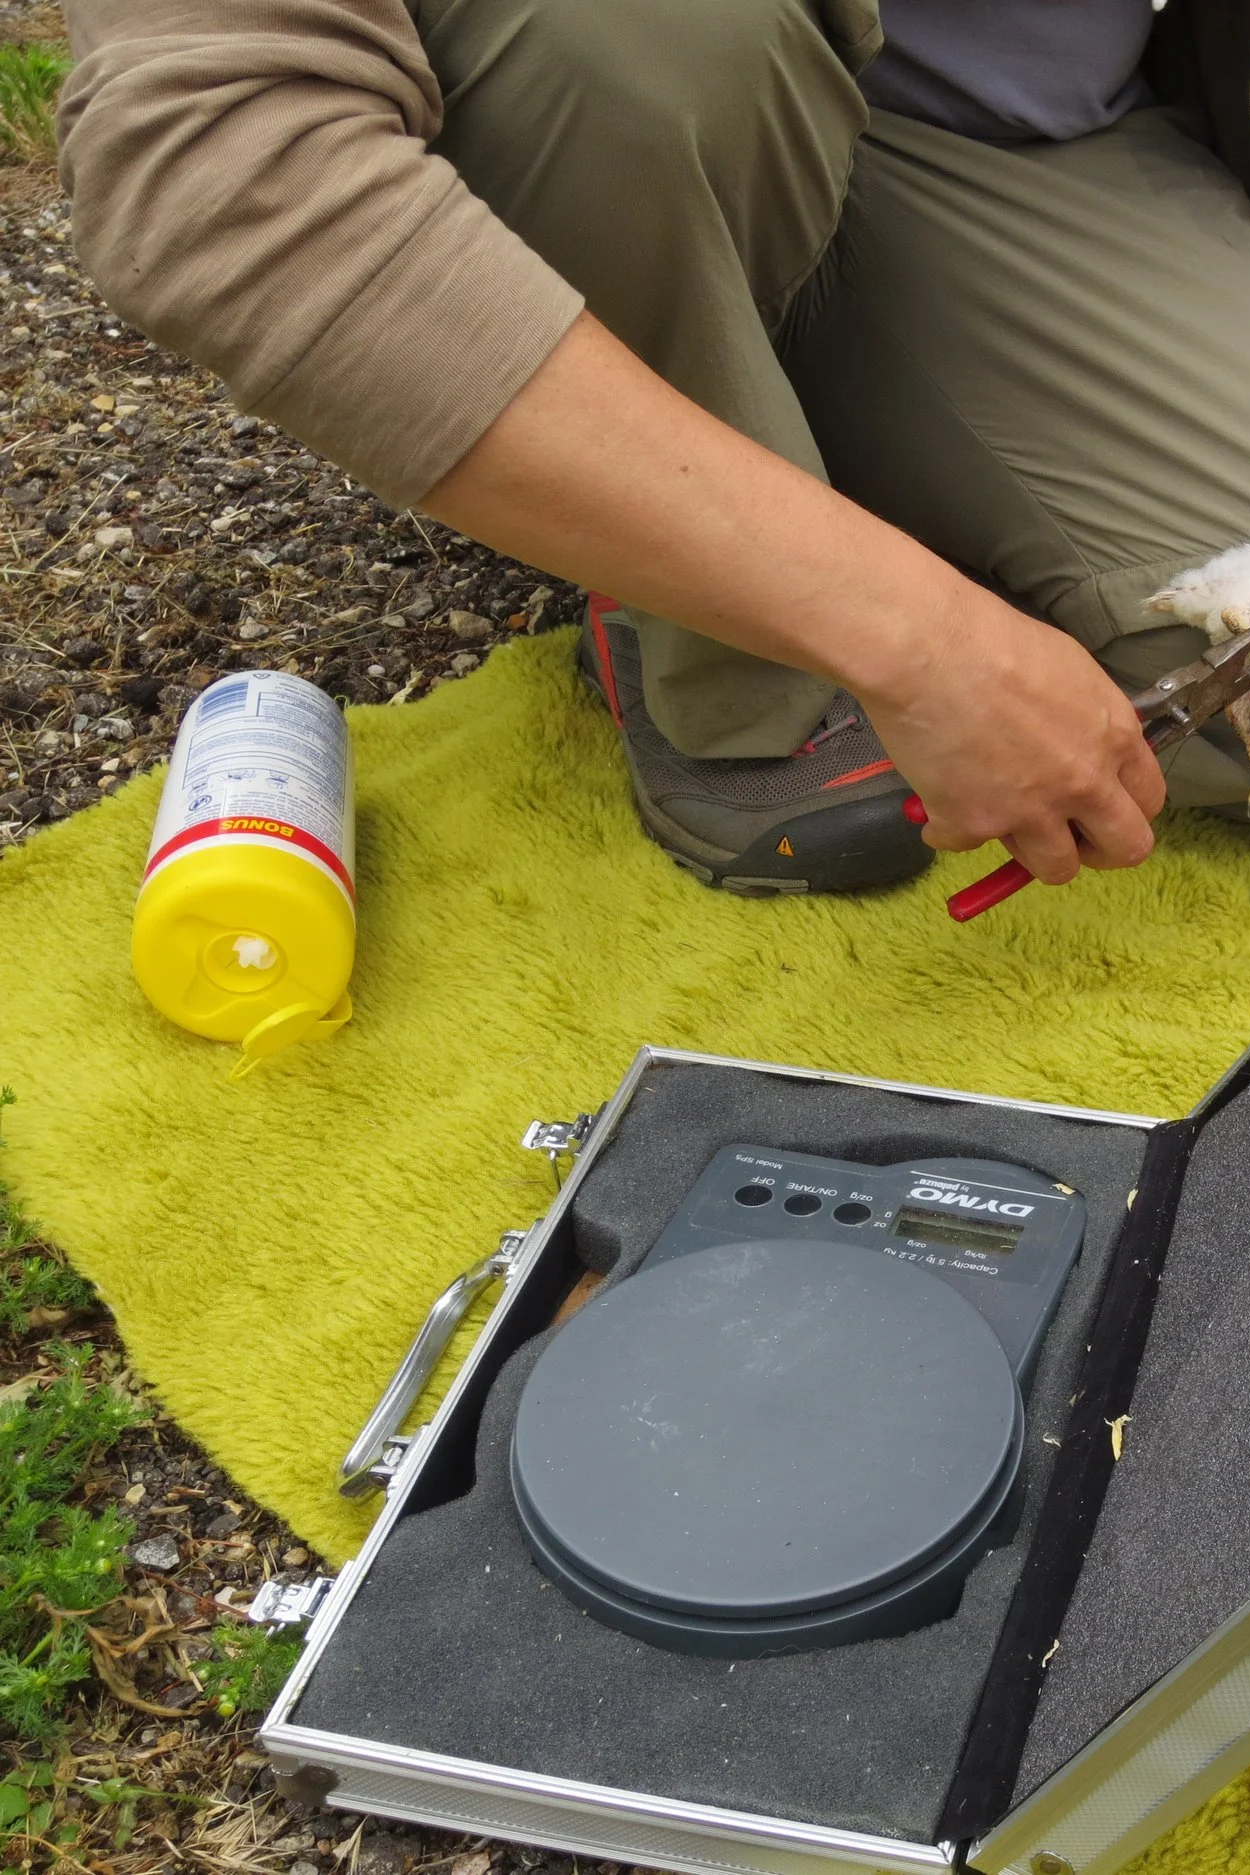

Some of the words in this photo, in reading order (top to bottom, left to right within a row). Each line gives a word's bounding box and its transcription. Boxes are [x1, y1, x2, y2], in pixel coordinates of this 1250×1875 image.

[220, 819, 295, 838] BONUS
[735, 1154, 754, 1164] SP5
[755, 1159, 783, 1170] Model
[751, 1176, 776, 1186] OFF
[786, 1182, 838, 1197] ON/TARE
[960, 1184, 970, 1193] by
[849, 1191, 874, 1202] oz/g
[909, 1187, 1035, 1218] DYMO
[884, 1210, 893, 1218] g
[873, 1221, 887, 1229] oz
[906, 1239, 927, 1249] oz/g
[899, 1251, 917, 1260] 2.2
[926, 1254, 937, 1265] lb
[964, 1249, 987, 1260] lb/kg
[938, 1258, 947, 1266] 5
[948, 1258, 999, 1276] Capacity:
